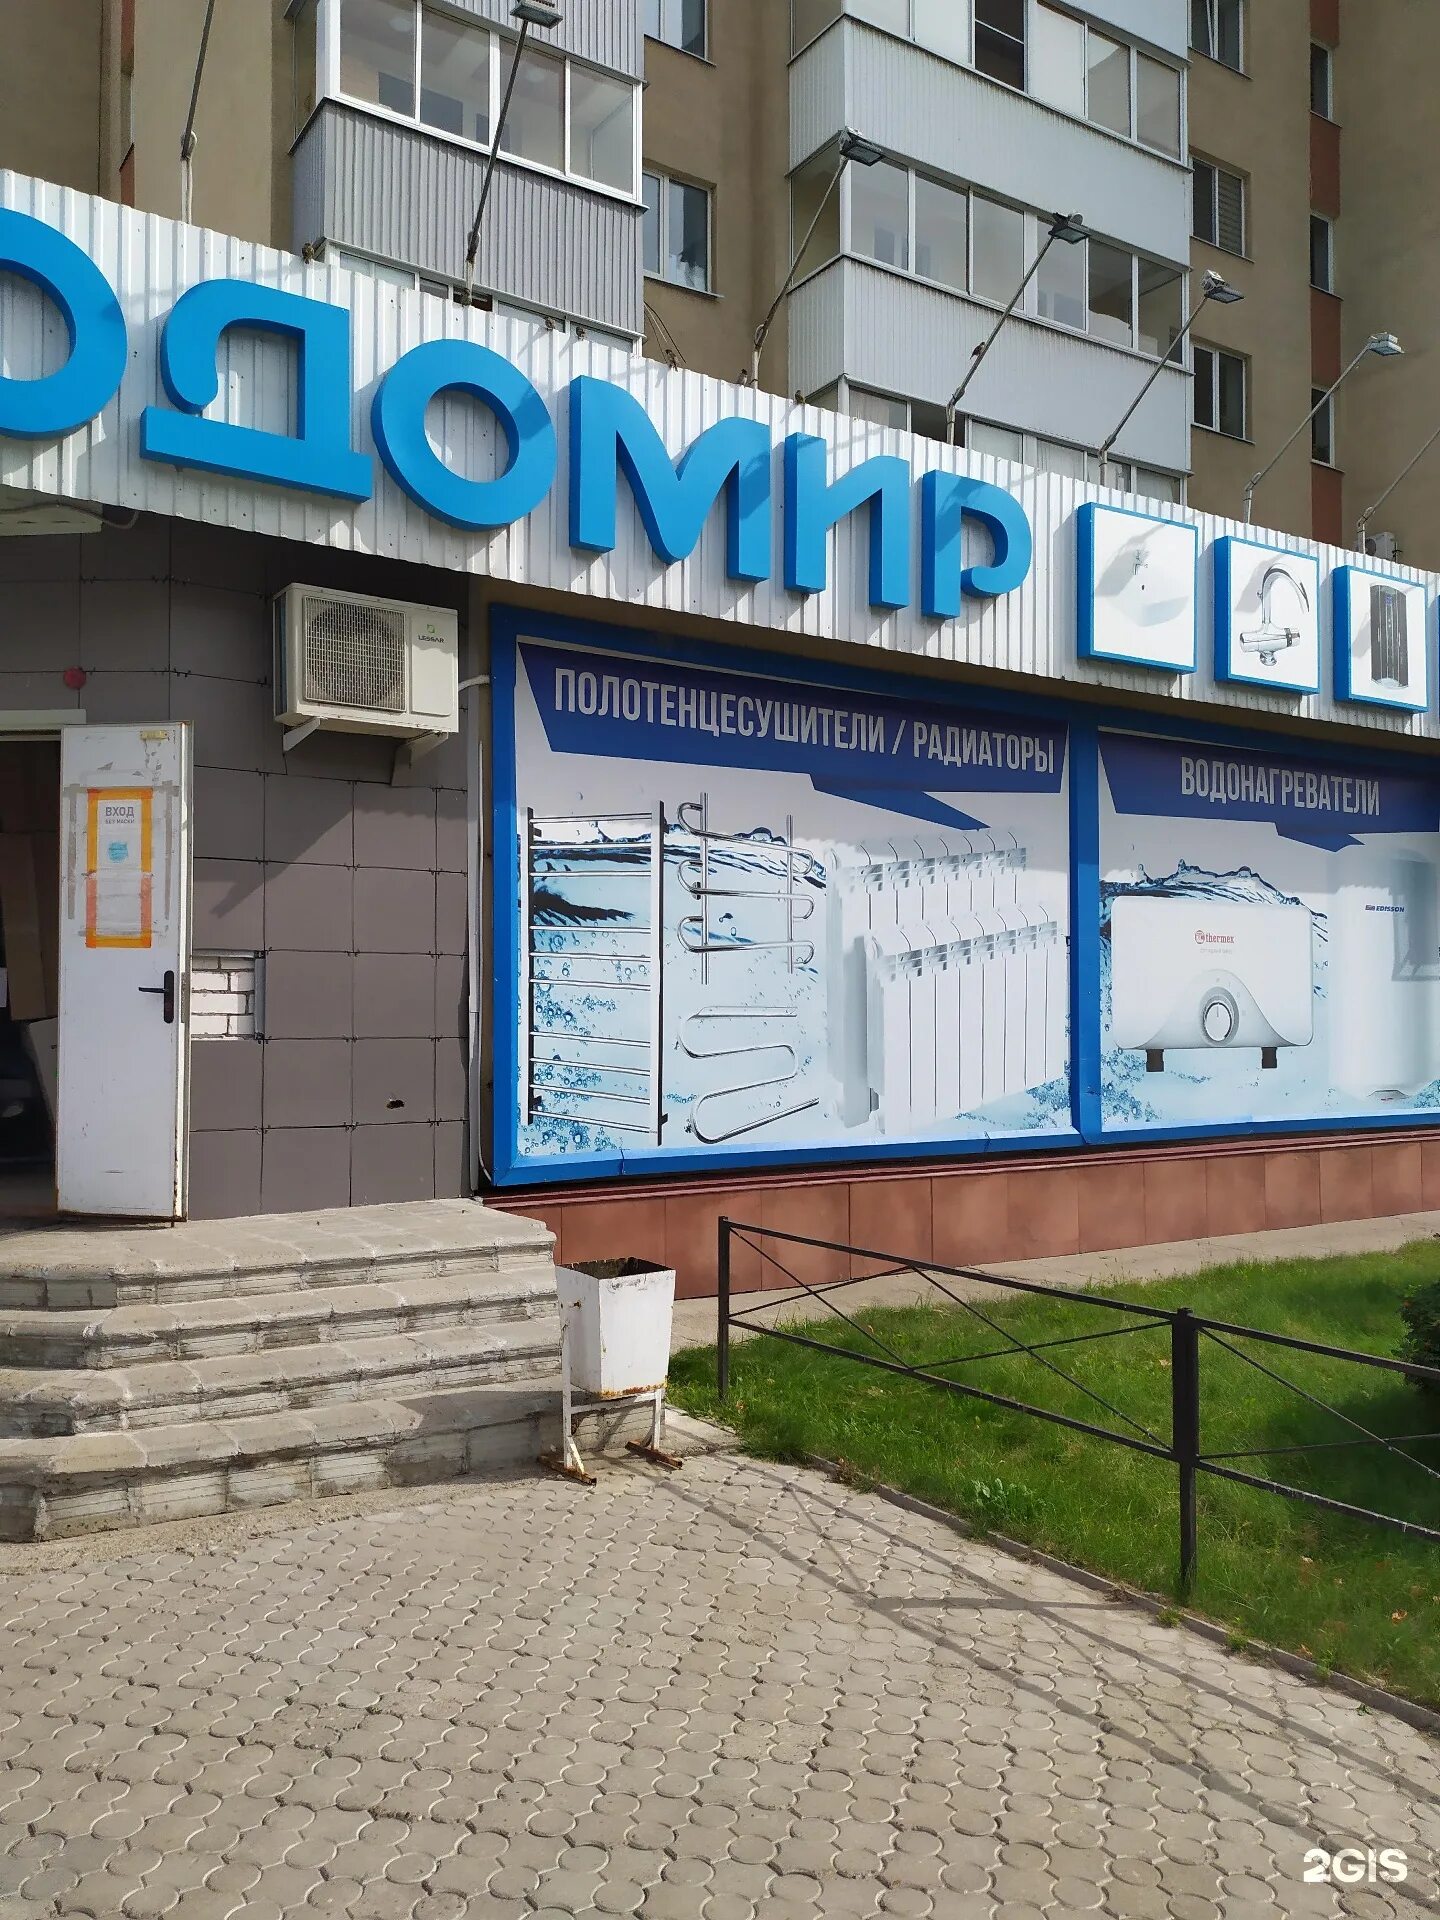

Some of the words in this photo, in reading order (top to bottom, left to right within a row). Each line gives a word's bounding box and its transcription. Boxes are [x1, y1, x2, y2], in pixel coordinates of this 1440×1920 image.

[555, 668, 885, 754] ПОЛОТЕНЦЕСУШИТЕЛИ
[891, 719, 907, 755] /
[913, 721, 1054, 774] РАДИАТОРЫ
[1181, 756, 1380, 816] ВОДОНАГРЕВАТЕЛИ
[105, 806, 135, 818] ВХОД
[1375, 905, 1405, 913] EDISSON
[1205, 932, 1235, 944] thermex
